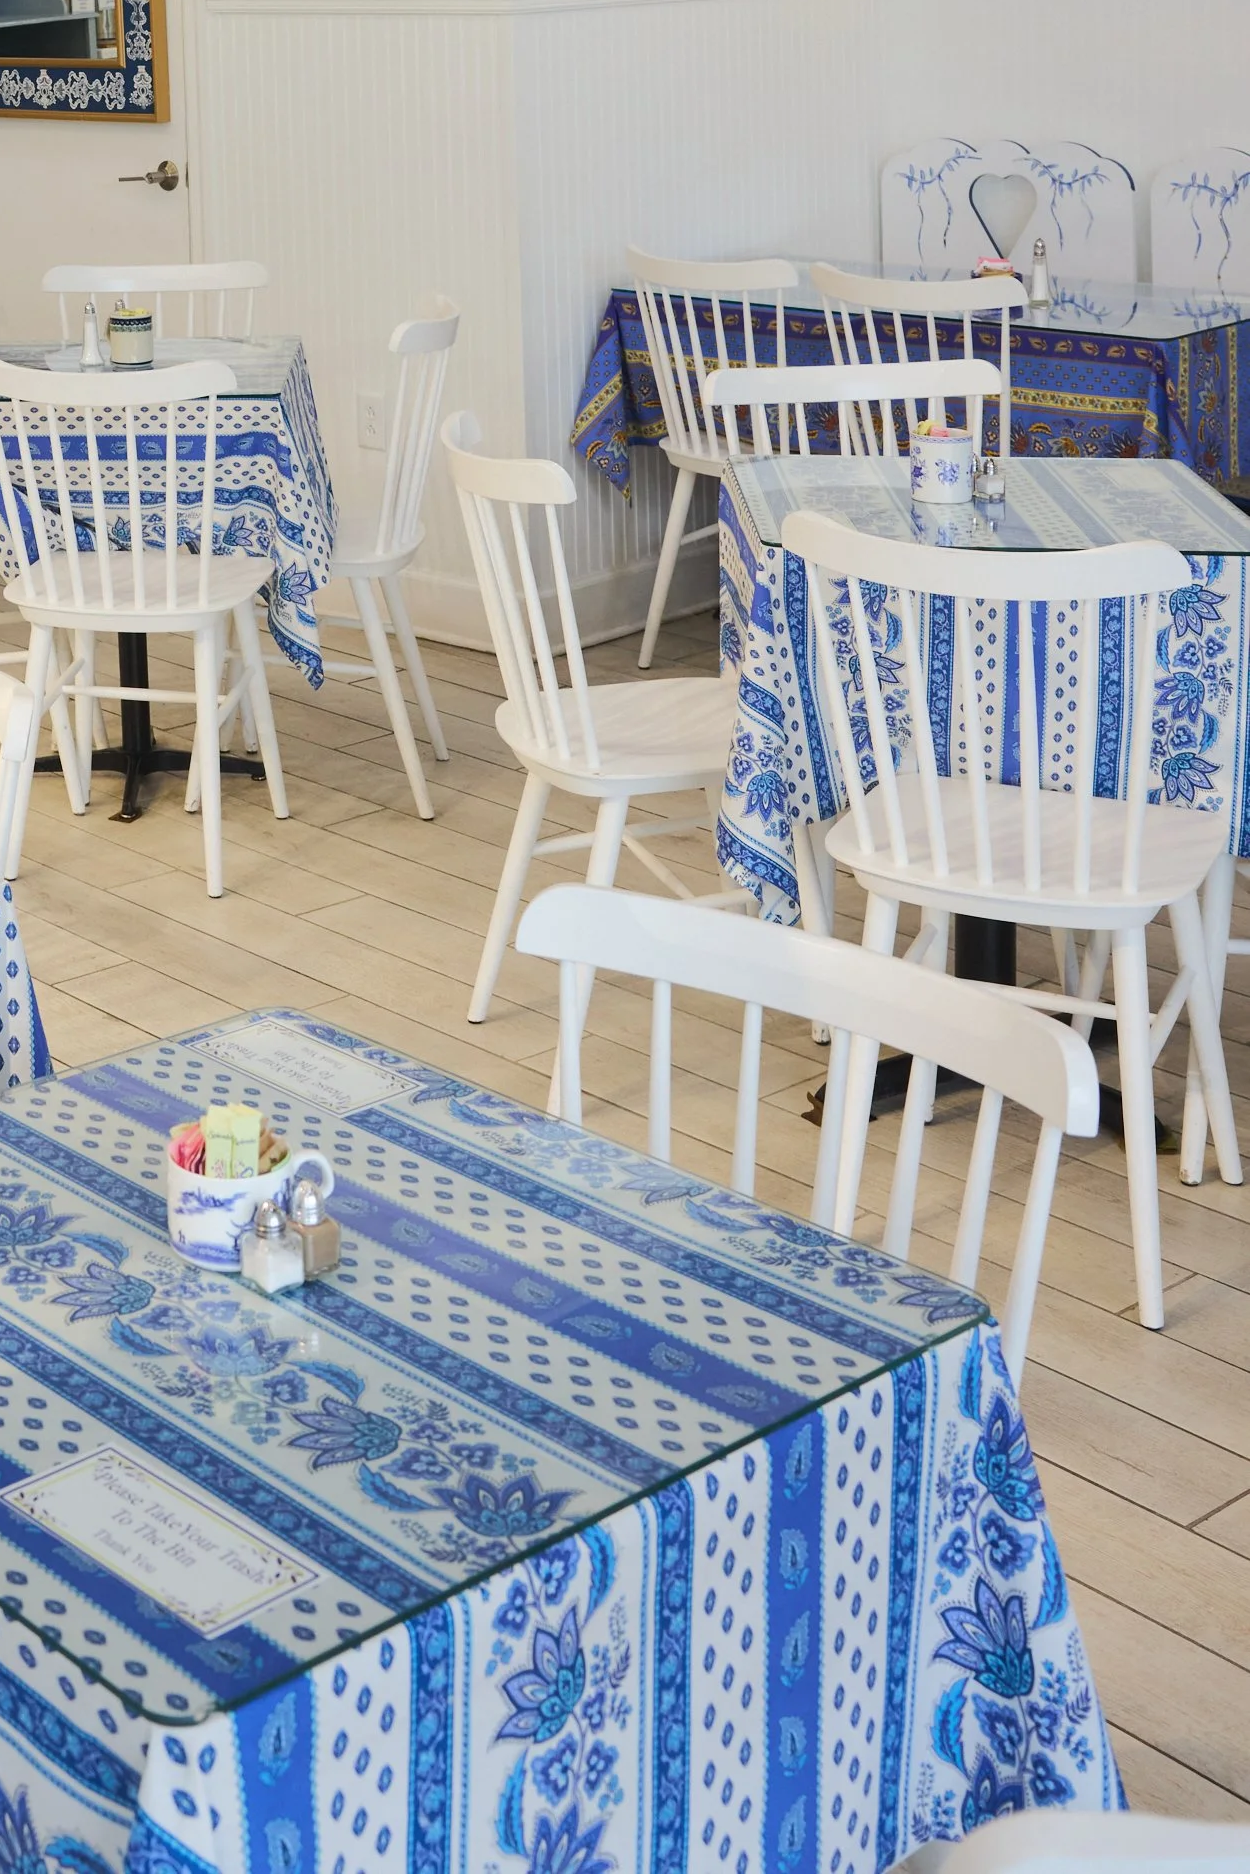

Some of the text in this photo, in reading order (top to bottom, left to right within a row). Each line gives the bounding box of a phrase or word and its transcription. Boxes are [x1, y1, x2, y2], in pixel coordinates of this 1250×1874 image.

[92, 1528, 158, 1573] Thank You
[95, 1471, 144, 1506] Please
[217, 1549, 266, 1584] Trash
[109, 1508, 198, 1568] To The Bin
